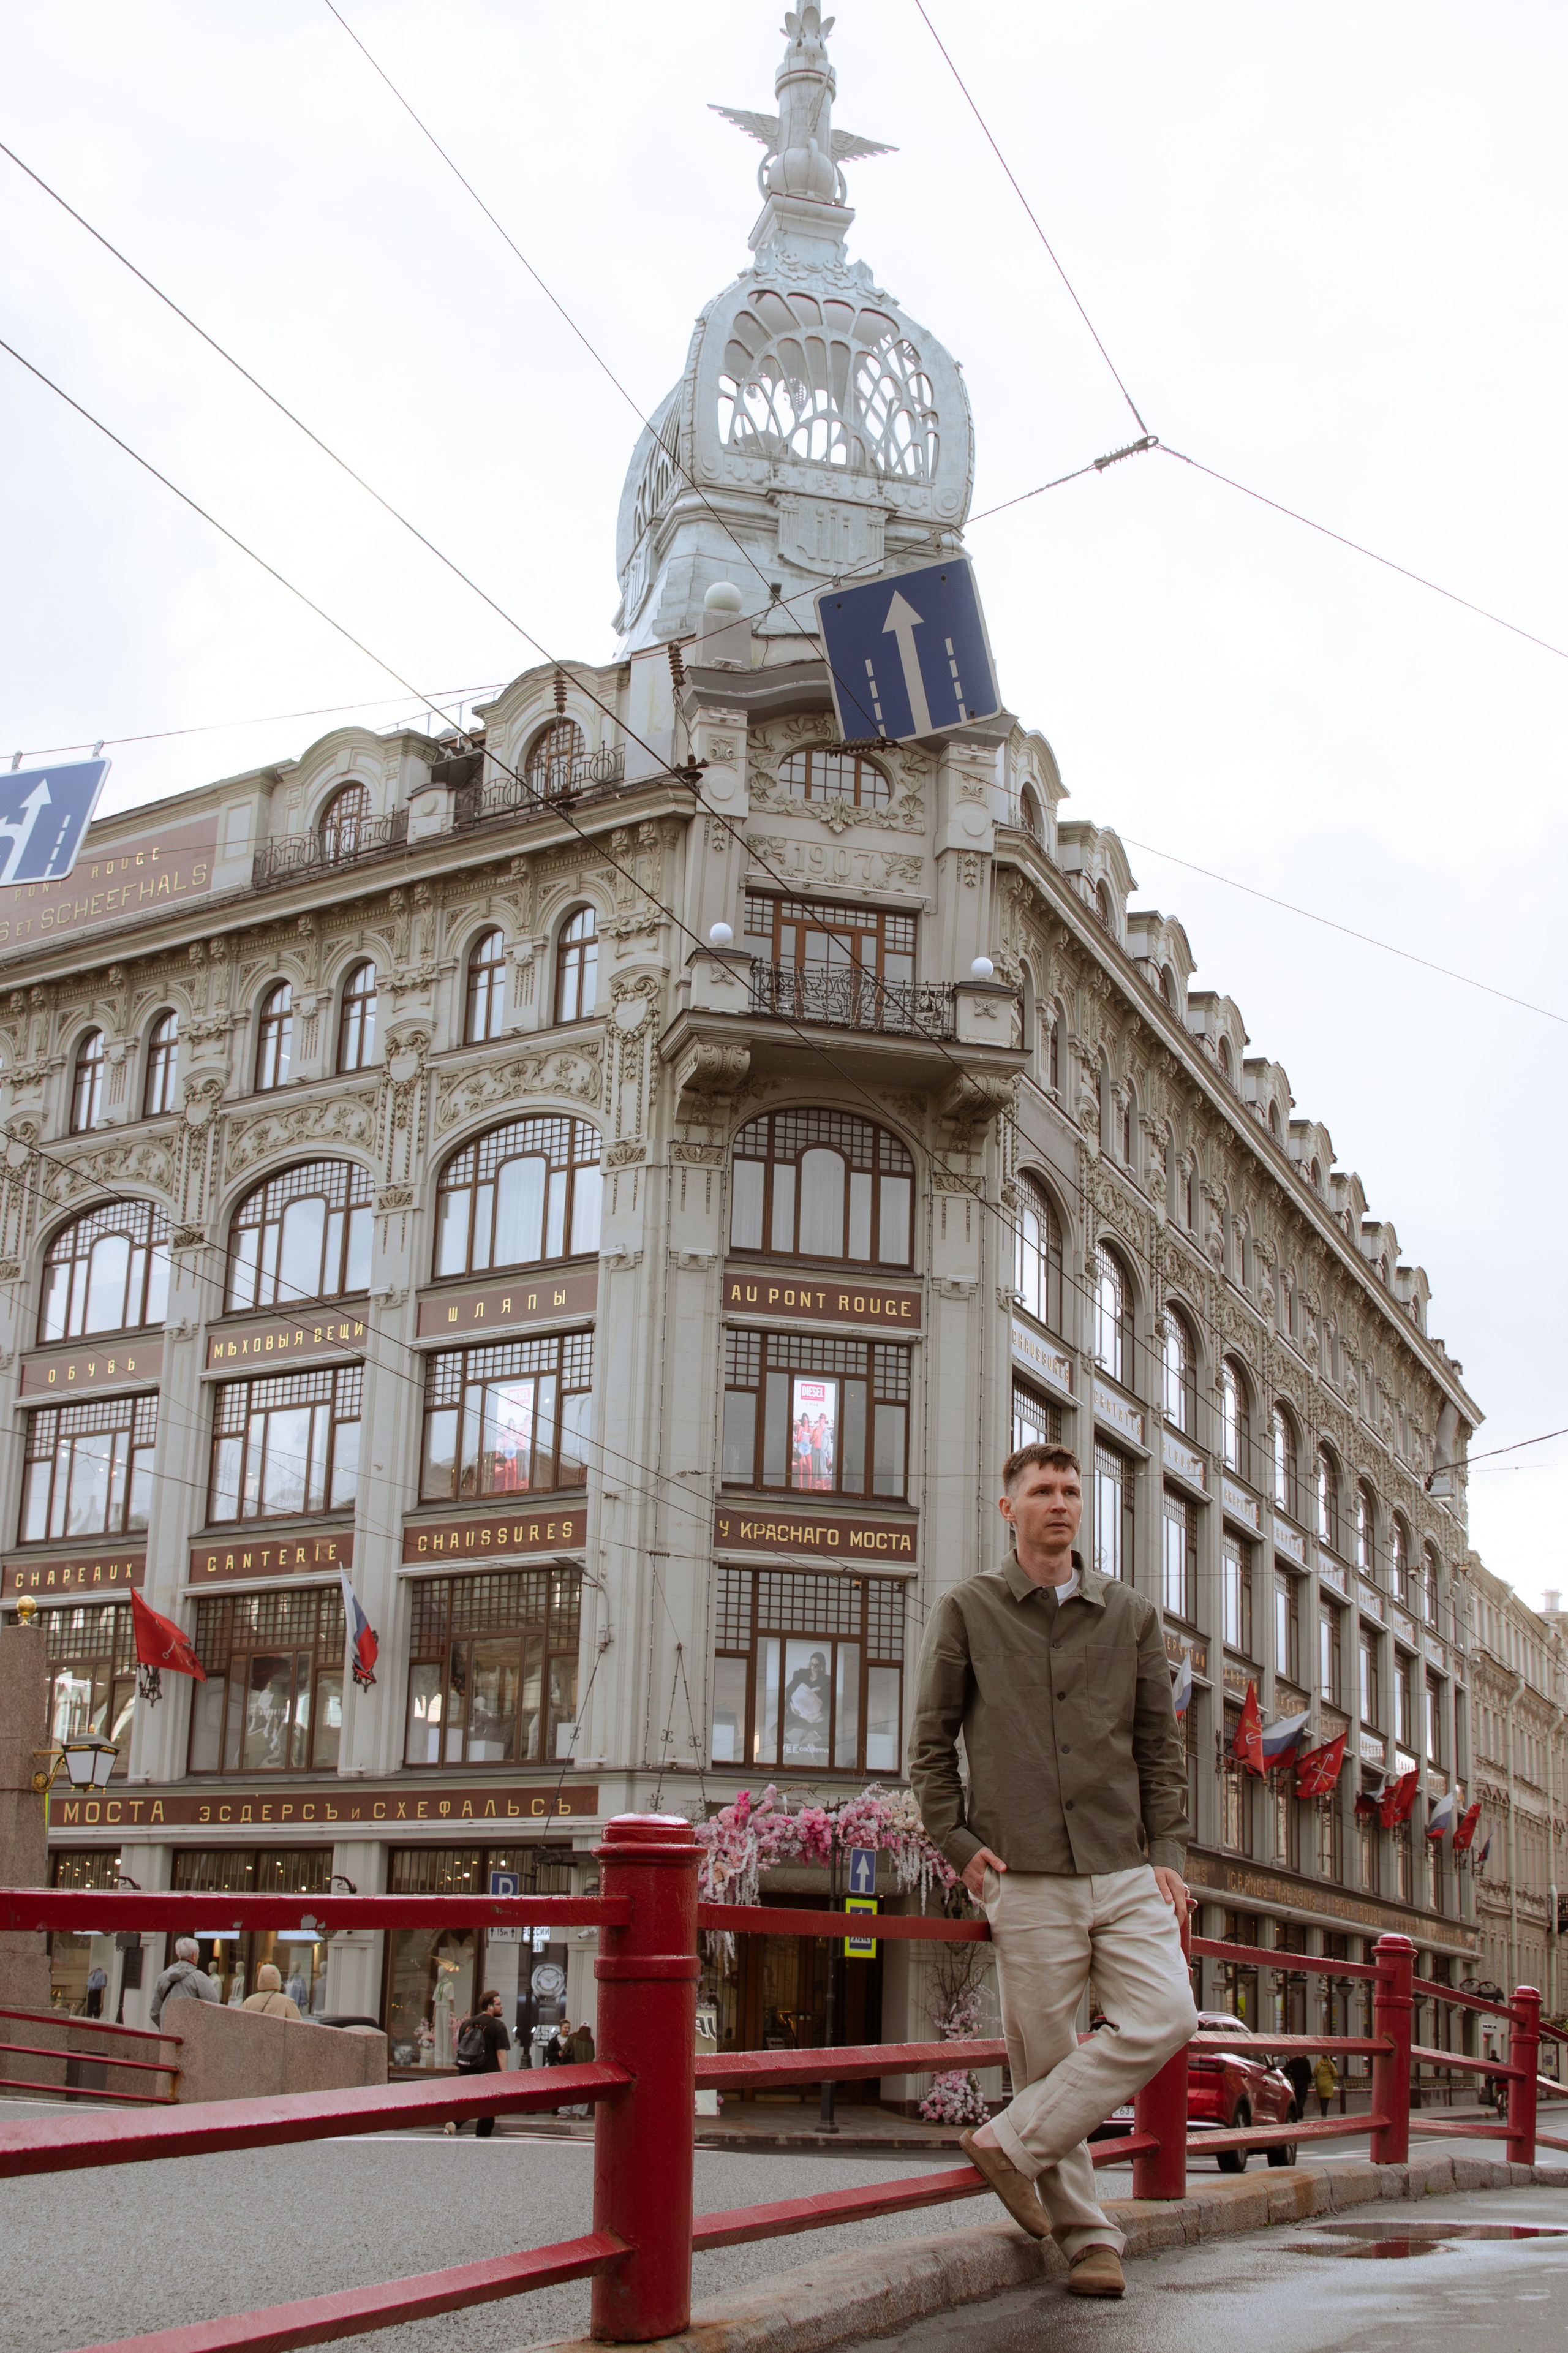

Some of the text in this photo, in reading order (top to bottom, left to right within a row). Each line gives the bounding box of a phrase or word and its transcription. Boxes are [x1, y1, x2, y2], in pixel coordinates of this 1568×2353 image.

[92, 847, 160, 878] ROUGE
[794, 843, 875, 880] 1907
[16, 920, 33, 936] ET
[40, 863, 207, 929] SCHEEFHALS
[448, 1289, 566, 1323] ШЛЯПЫ
[731, 1284, 912, 1318] AU PONT ROUGE
[314, 1321, 364, 1343] ВЕЩИ
[47, 1357, 136, 1383] ОБУВЬ
[1012, 1328, 1069, 1383] CHAUSSURES
[802, 1385, 824, 1398] DIESEL
[1093, 1389, 1142, 1435] CRAVATES
[417, 1521, 573, 1552] CHAUSSURES
[719, 1520, 911, 1552] У КРАСНАГО МОСТА
[15, 1563, 132, 1588] CHAPEAUX
[63, 1800, 165, 1824] МОСТА
[199, 1803, 338, 1823] ЭСДЕРСЪ
[372, 1797, 571, 1819] СХЕФАЛЬСЪ
